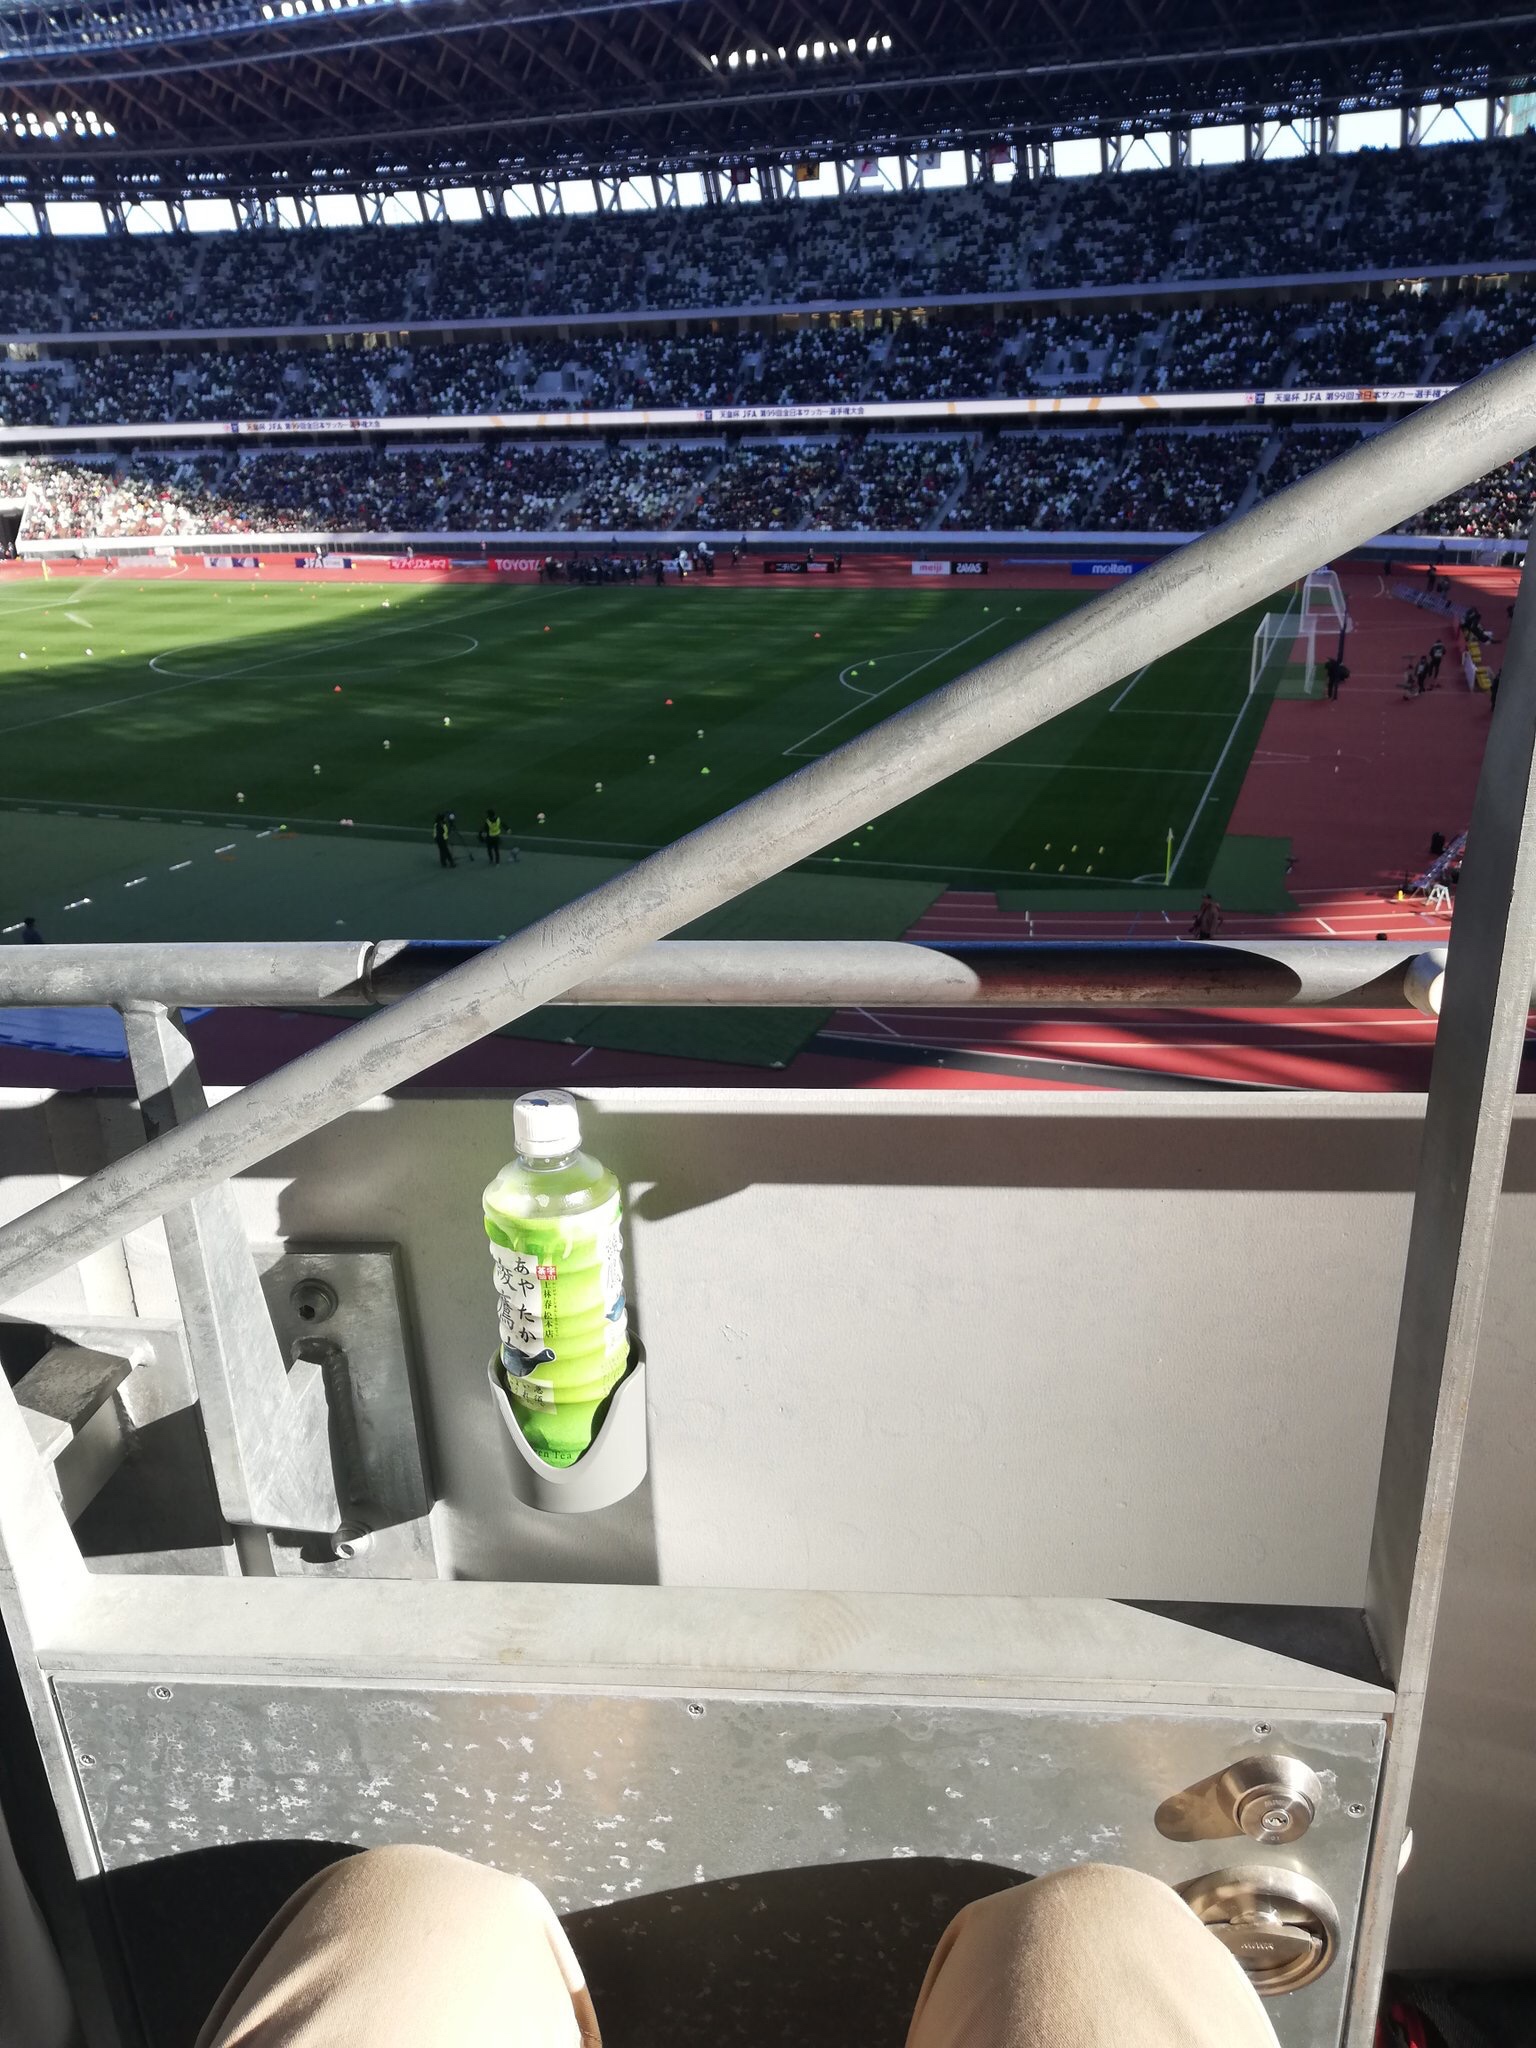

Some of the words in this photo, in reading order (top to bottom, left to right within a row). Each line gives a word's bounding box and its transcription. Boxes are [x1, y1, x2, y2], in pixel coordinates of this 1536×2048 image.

[1274, 393, 1299, 402] 天皇杯
[1302, 392, 1322, 401] JFA
[743, 410, 757, 418] JFA
[919, 563, 943, 574] meiji
[956, 563, 982, 573] SAVAS
[1092, 562, 1132, 574] molten
[513, 1256, 537, 1343] あやたか
[554, 1451, 572, 1460] Tea
